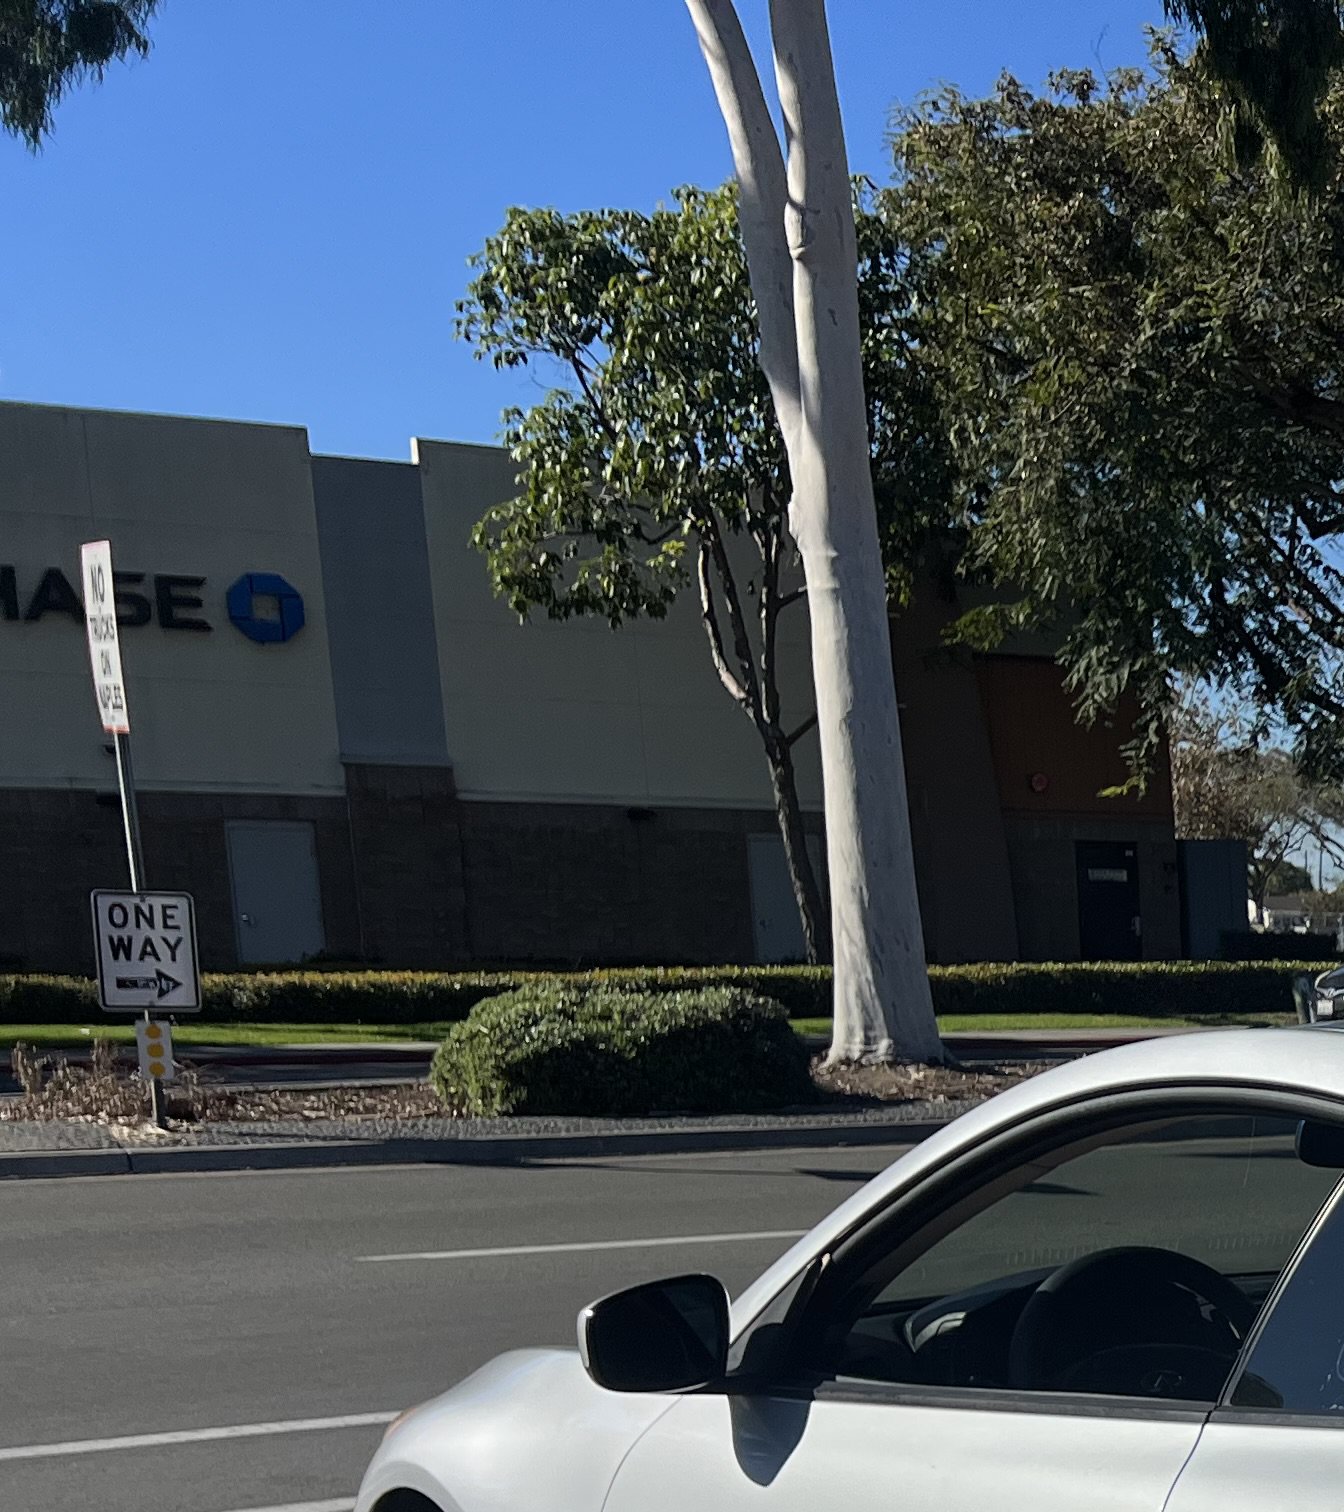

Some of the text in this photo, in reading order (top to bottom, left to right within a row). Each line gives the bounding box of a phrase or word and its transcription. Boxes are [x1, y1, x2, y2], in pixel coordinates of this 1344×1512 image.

[90, 563, 105, 603] NO
[108, 902, 181, 930] ONE
[108, 934, 184, 962] WAY
